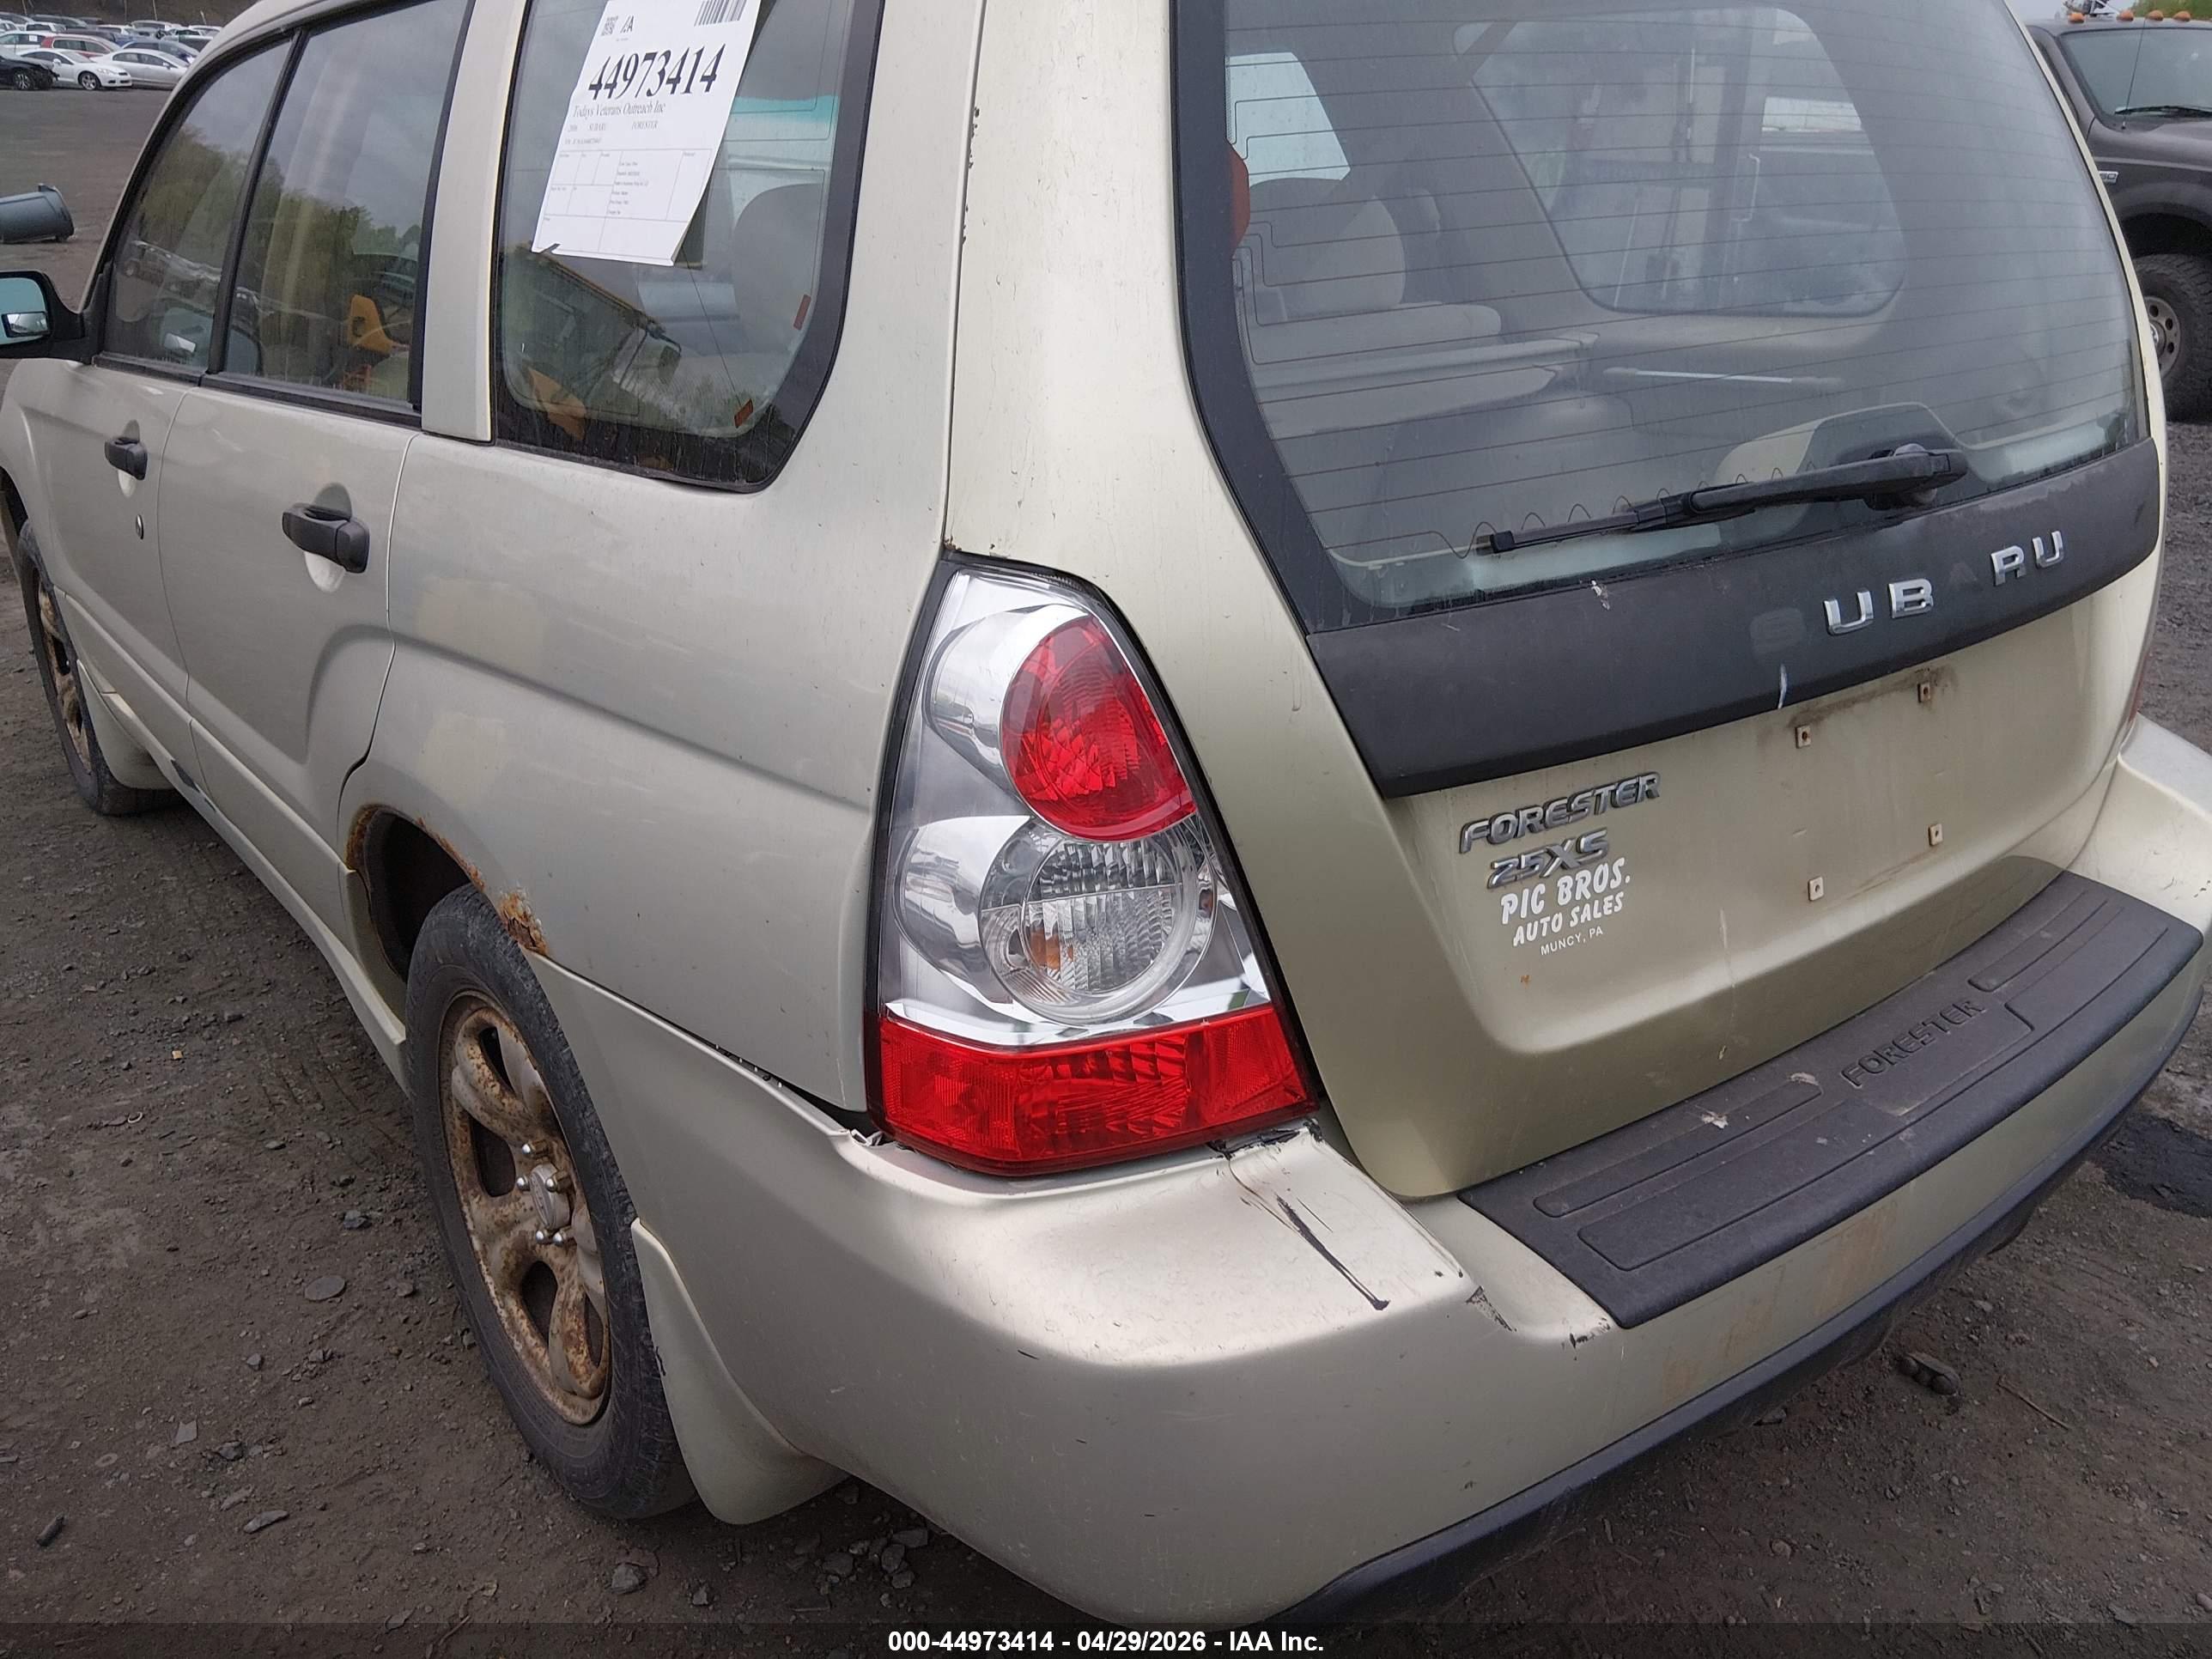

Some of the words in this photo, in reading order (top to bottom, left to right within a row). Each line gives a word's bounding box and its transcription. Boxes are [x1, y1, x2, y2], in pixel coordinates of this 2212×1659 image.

[588, 43, 726, 100] 44973414
[623, 100, 653, 115] Outreach
[653, 100, 666, 114] Inc
[1459, 771, 1662, 854] FORESTER
[1557, 857, 1631, 906] BROS.
[1512, 912, 1563, 947] AUTO
[1569, 891, 1625, 928] SALES
[1540, 933, 1587, 956] MUNCY,
[1589, 925, 1604, 939] PA
[1840, 999, 1987, 1089] FORESTER
